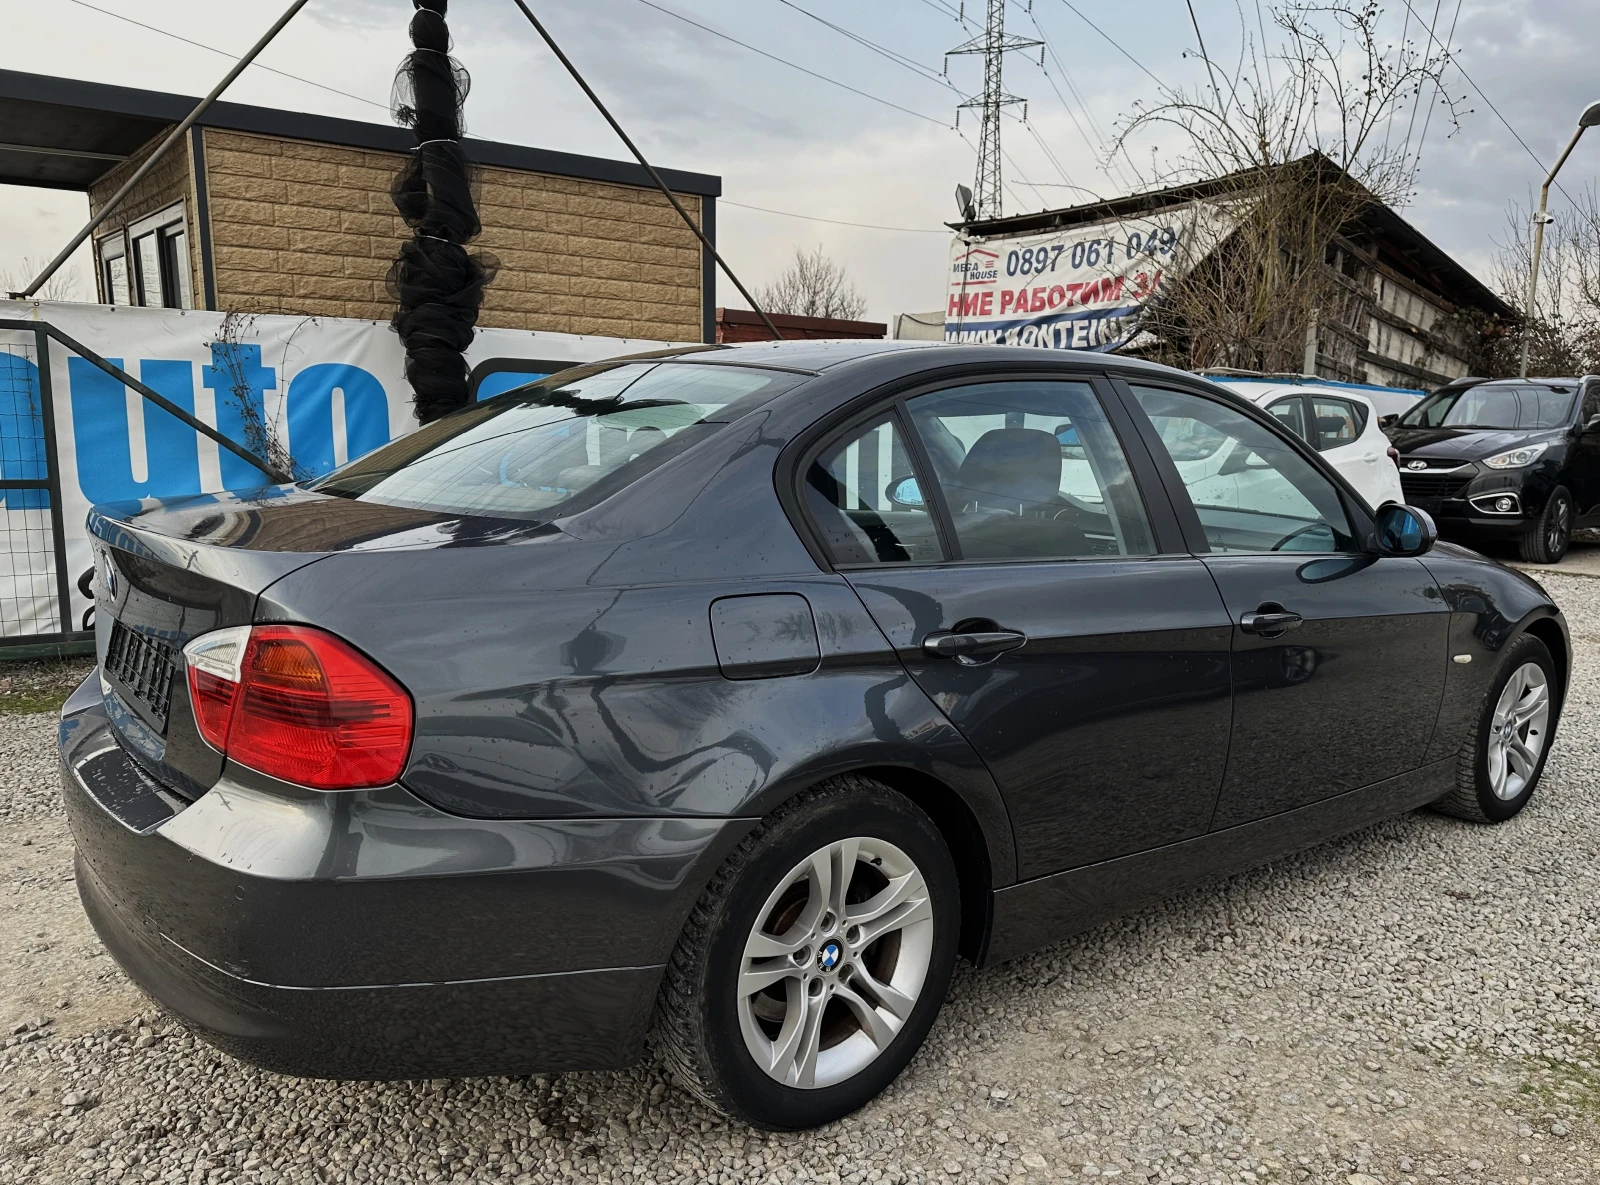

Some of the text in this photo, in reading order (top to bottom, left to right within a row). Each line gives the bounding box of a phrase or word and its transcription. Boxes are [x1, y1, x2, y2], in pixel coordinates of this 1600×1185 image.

[1006, 226, 1176, 277] 0897 061 049
[953, 262, 979, 272] MEGA
[970, 270, 998, 281] HOUSE
[948, 291, 994, 317] НИЕ
[1000, 275, 1125, 315] РАБОТИМ
